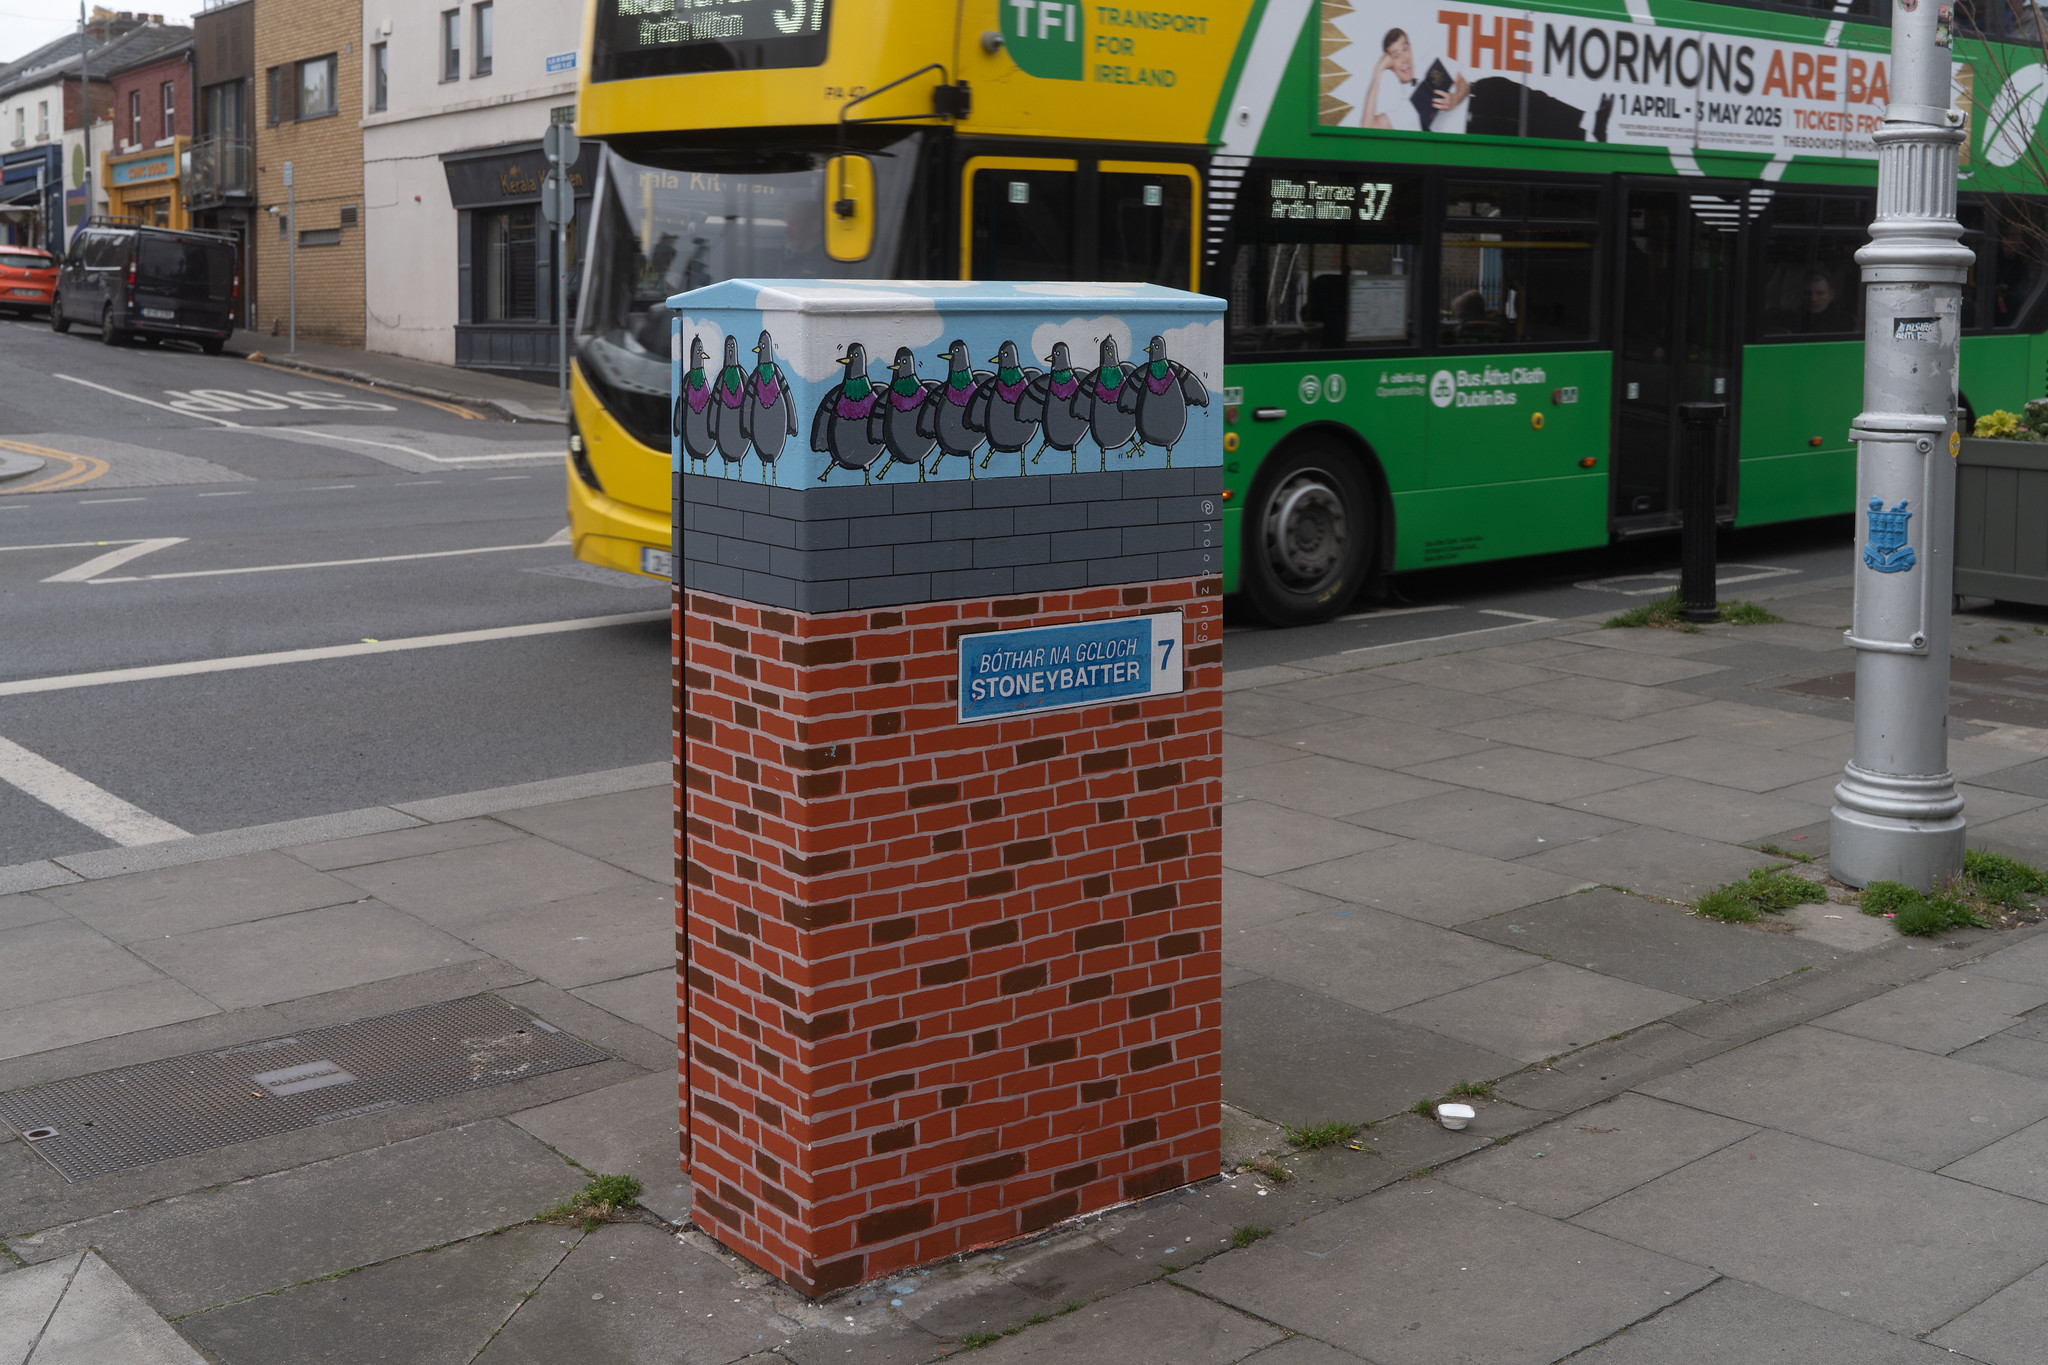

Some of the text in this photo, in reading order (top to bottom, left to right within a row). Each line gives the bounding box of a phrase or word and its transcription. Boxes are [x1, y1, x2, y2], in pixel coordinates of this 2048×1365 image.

[772, 0, 824, 34] 37
[1008, 0, 1076, 42] TFI
[1095, 6, 1209, 35] TRANSPORT
[1094, 35, 1135, 56] FOR
[1437, 10, 1533, 73] THE
[1543, 22, 1755, 96] MORMONS
[1762, 49, 1837, 101] ARE
[1094, 64, 1176, 88] IRELAND
[1620, 94, 1626, 115] 1
[1631, 95, 1680, 118] APRIL
[1696, 101, 1704, 122] 3
[1708, 102, 1742, 124] MAY
[1745, 105, 1782, 127] 2025
[1793, 109, 1854, 132] TICKETS
[500, 172, 536, 194] Kerala
[1271, 179, 1356, 200] Wilton Terrace
[1315, 201, 1351, 219] Wilton
[1359, 182, 1393, 220] 37
[1456, 365, 1546, 387] Bus Átha Cliath
[163, 389, 398, 412] STOP
[1455, 389, 1517, 408] Dublin Bus
[979, 638, 1138, 674] BÓTHAR NA GCLOCH
[1157, 639, 1175, 671] 7
[971, 661, 1140, 700] STONEYBATTER
